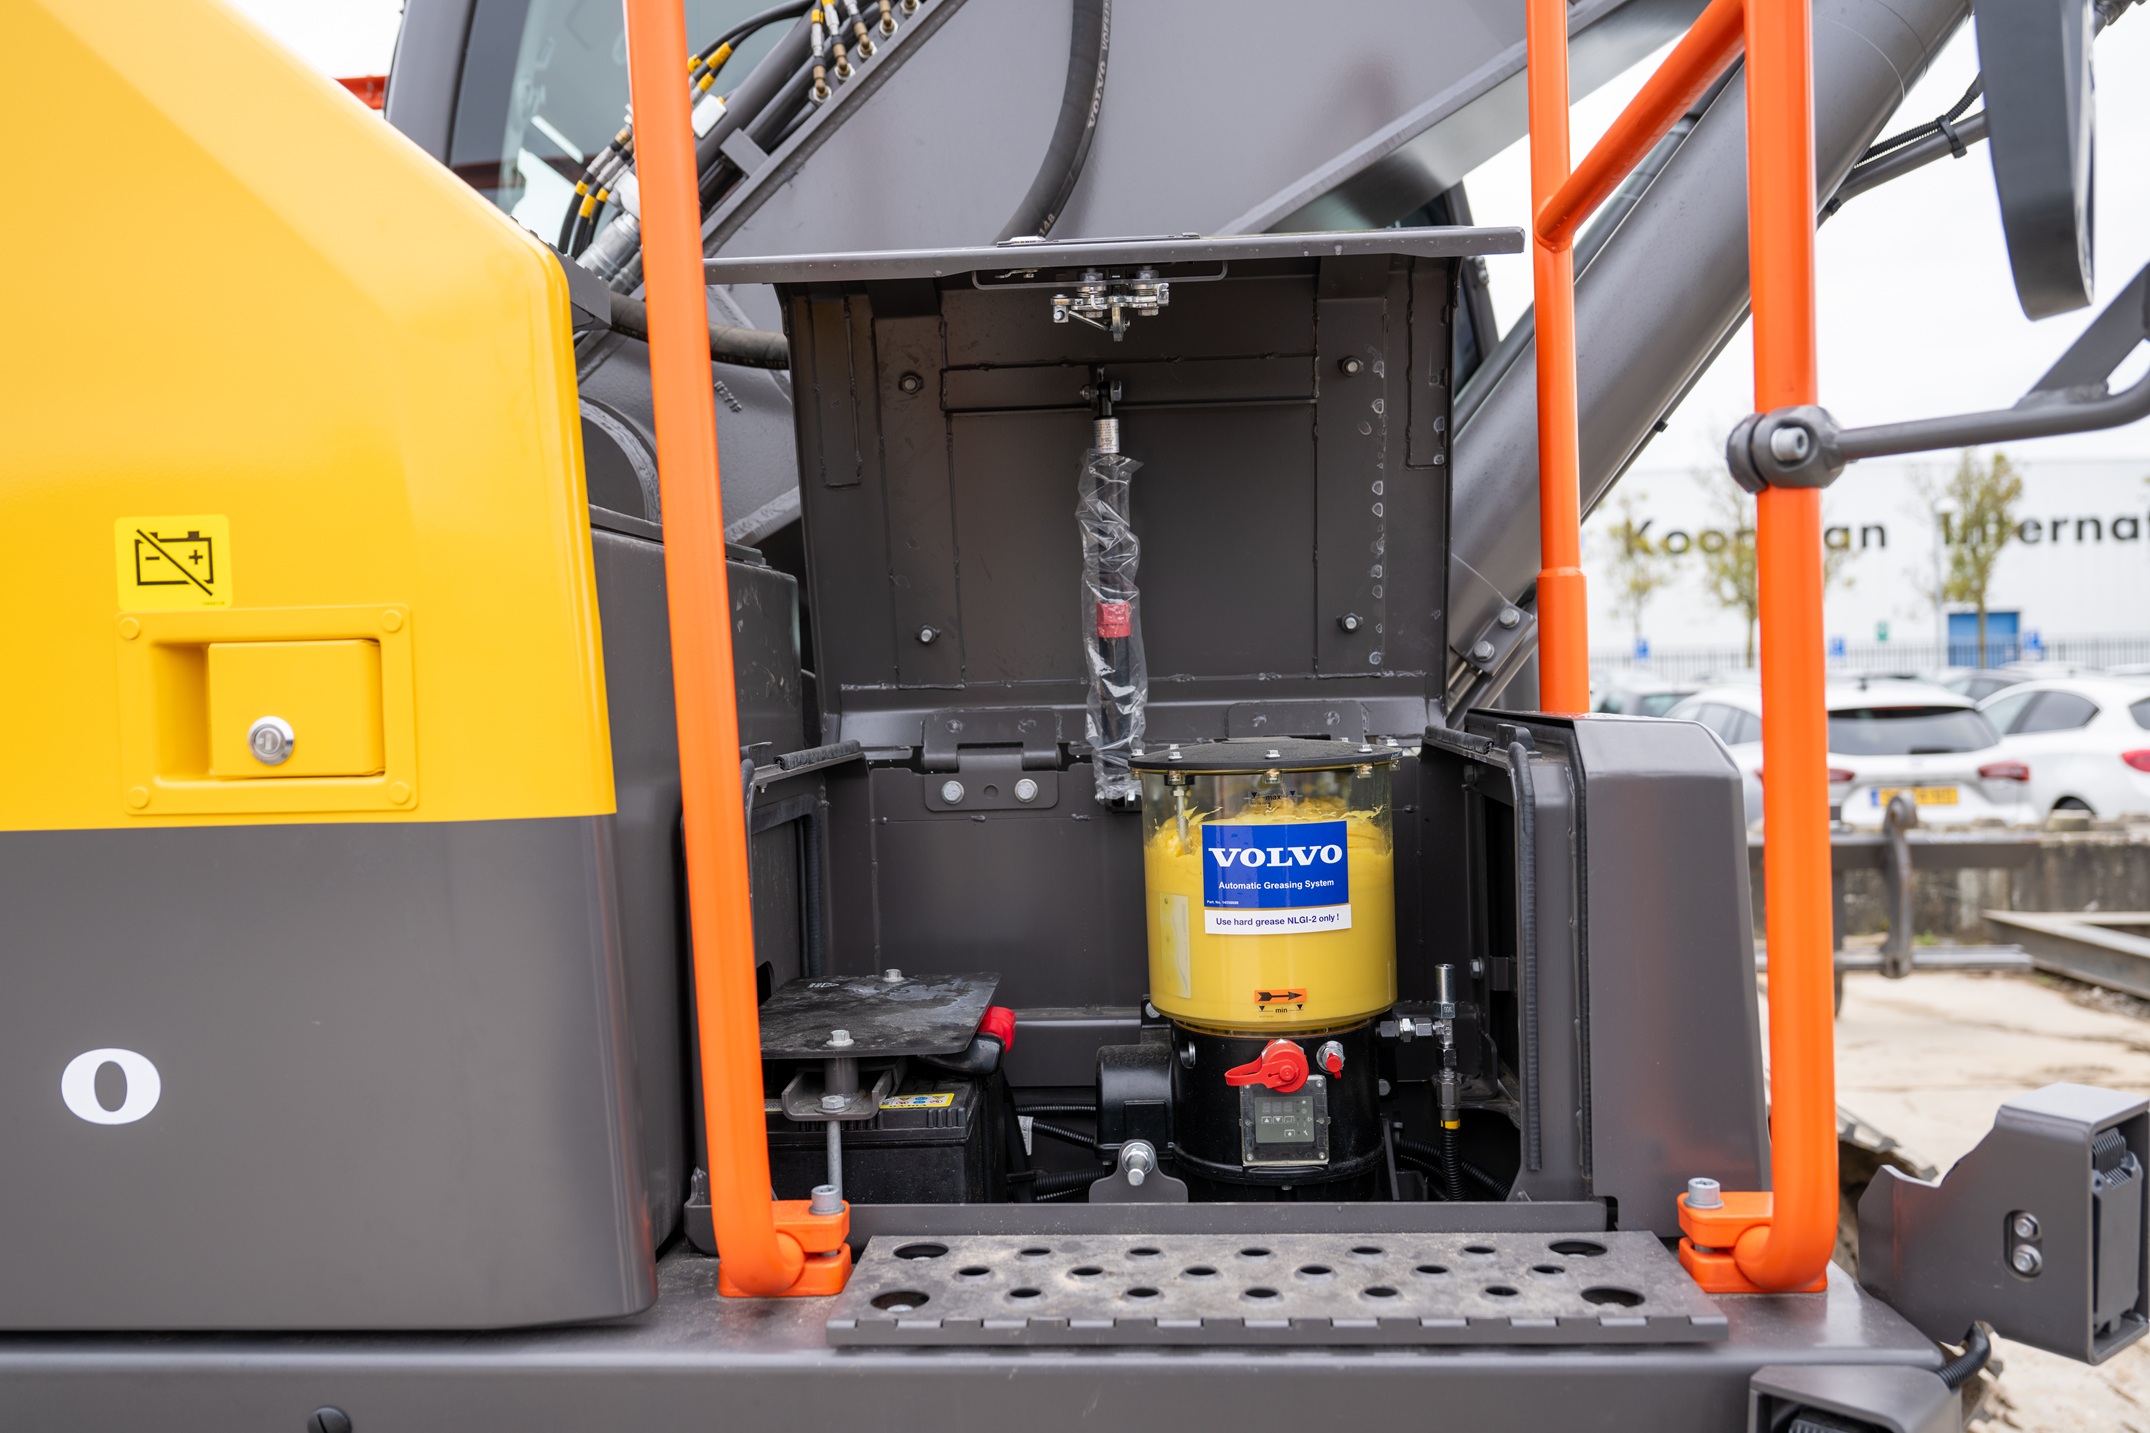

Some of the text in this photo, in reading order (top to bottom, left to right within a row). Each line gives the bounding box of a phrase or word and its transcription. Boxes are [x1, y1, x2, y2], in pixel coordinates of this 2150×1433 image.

[1087, 60, 1106, 129] VOLVO
[1208, 844, 1343, 868] VOLVO
[1218, 878, 1335, 890] Automatic Greasing System
[1215, 917, 1232, 926] Use
[1233, 917, 1253, 926] hard
[1255, 918, 1285, 927] grease
[1287, 915, 1317, 925] NLGI-2
[1318, 914, 1335, 923] only
